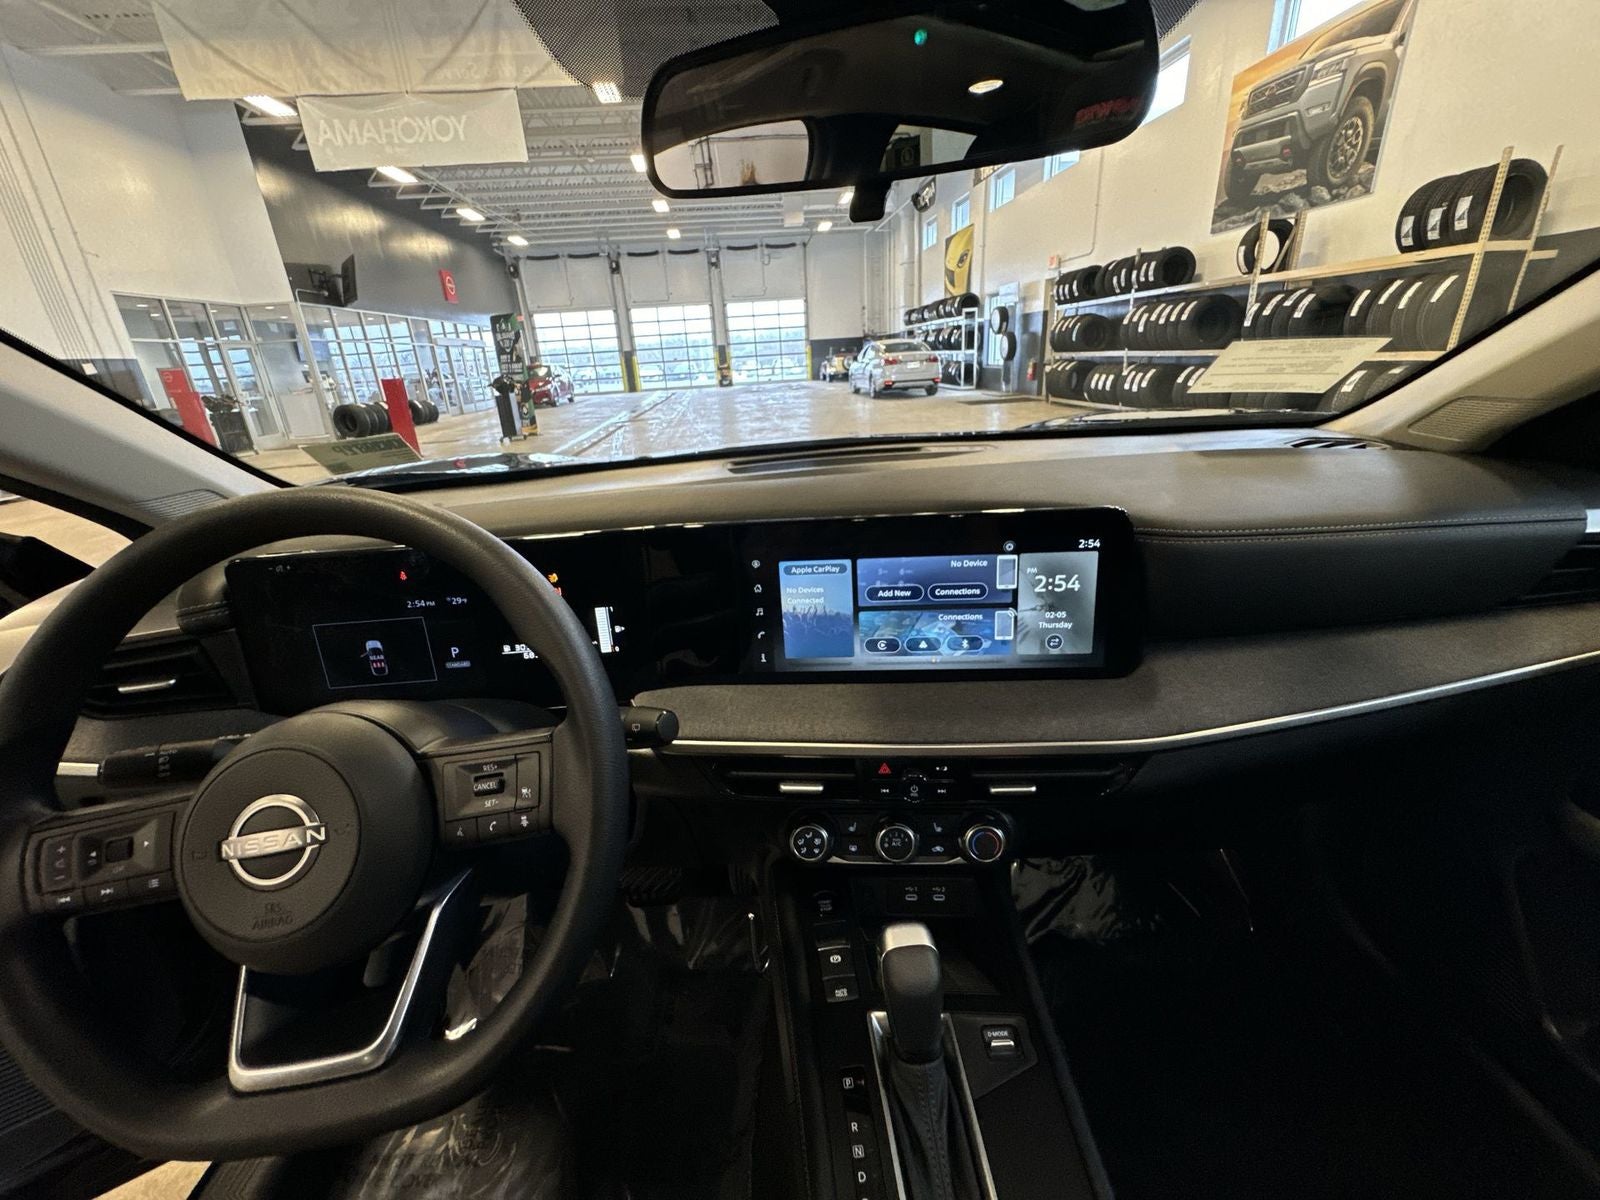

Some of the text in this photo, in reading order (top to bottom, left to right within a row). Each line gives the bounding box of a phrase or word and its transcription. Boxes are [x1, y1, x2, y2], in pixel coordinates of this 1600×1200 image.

[1078, 539, 1101, 549] 2:54
[962, 559, 988, 567] Device
[791, 565, 840, 575] Apple CarPlay
[1034, 574, 1081, 592] 2:54
[878, 589, 911, 597] Add New
[935, 588, 981, 596] Connections
[938, 613, 983, 622] Connections
[1045, 611, 1067, 619] 02-05
[1039, 621, 1073, 630] Thursday
[450, 647, 460, 658] P
[473, 781, 497, 791] CANCEL
[221, 825, 326, 858] NISSAN
[851, 1121, 859, 1133] R
[857, 1171, 867, 1183] D
